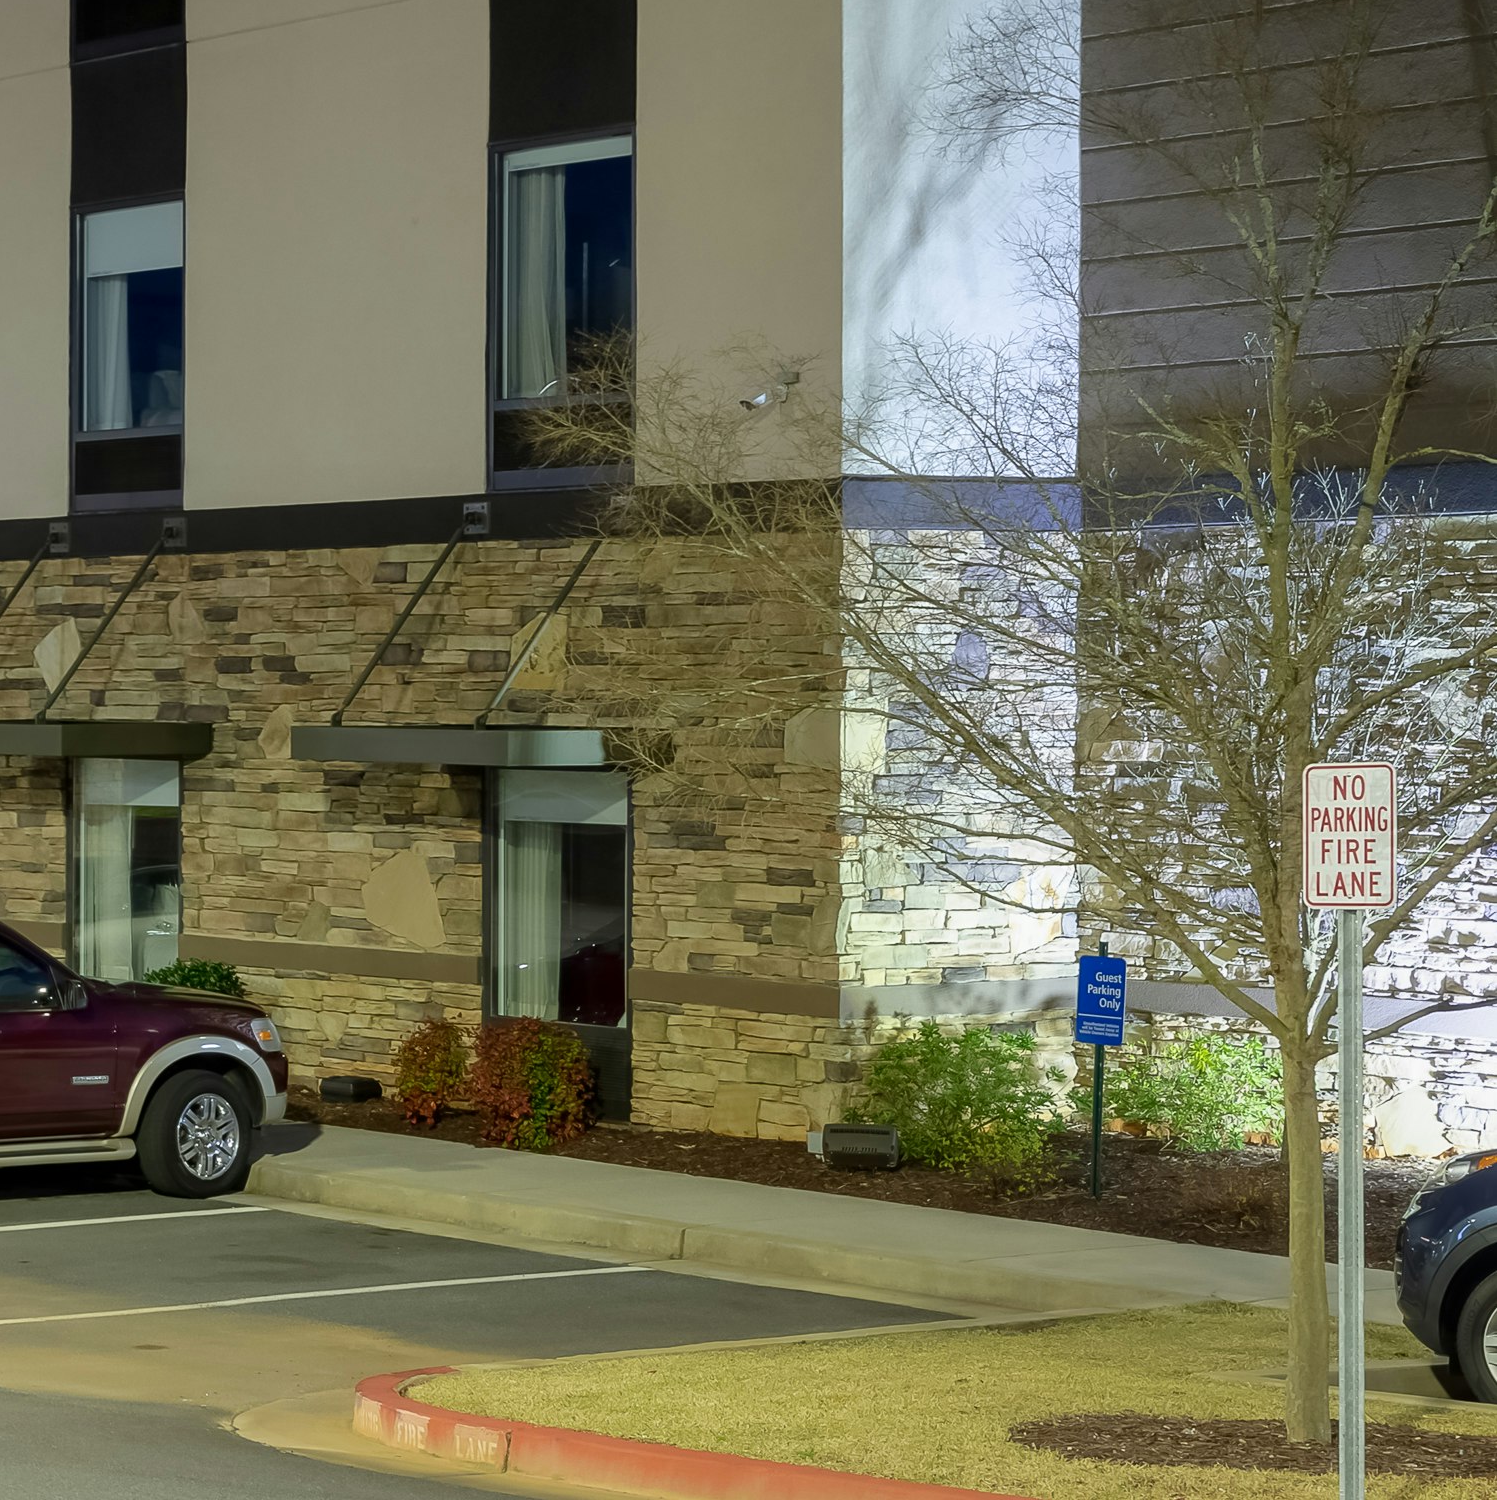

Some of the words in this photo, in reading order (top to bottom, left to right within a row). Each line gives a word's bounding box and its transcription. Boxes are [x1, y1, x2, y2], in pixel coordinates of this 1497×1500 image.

[1333, 774, 1366, 801] NO
[1311, 806, 1388, 832] PARKING
[1321, 839, 1376, 864] FIRE
[1316, 871, 1382, 897] LANE
[1095, 971, 1122, 984] Guest
[1087, 984, 1121, 999] Parking
[1099, 997, 1121, 1011] Only
